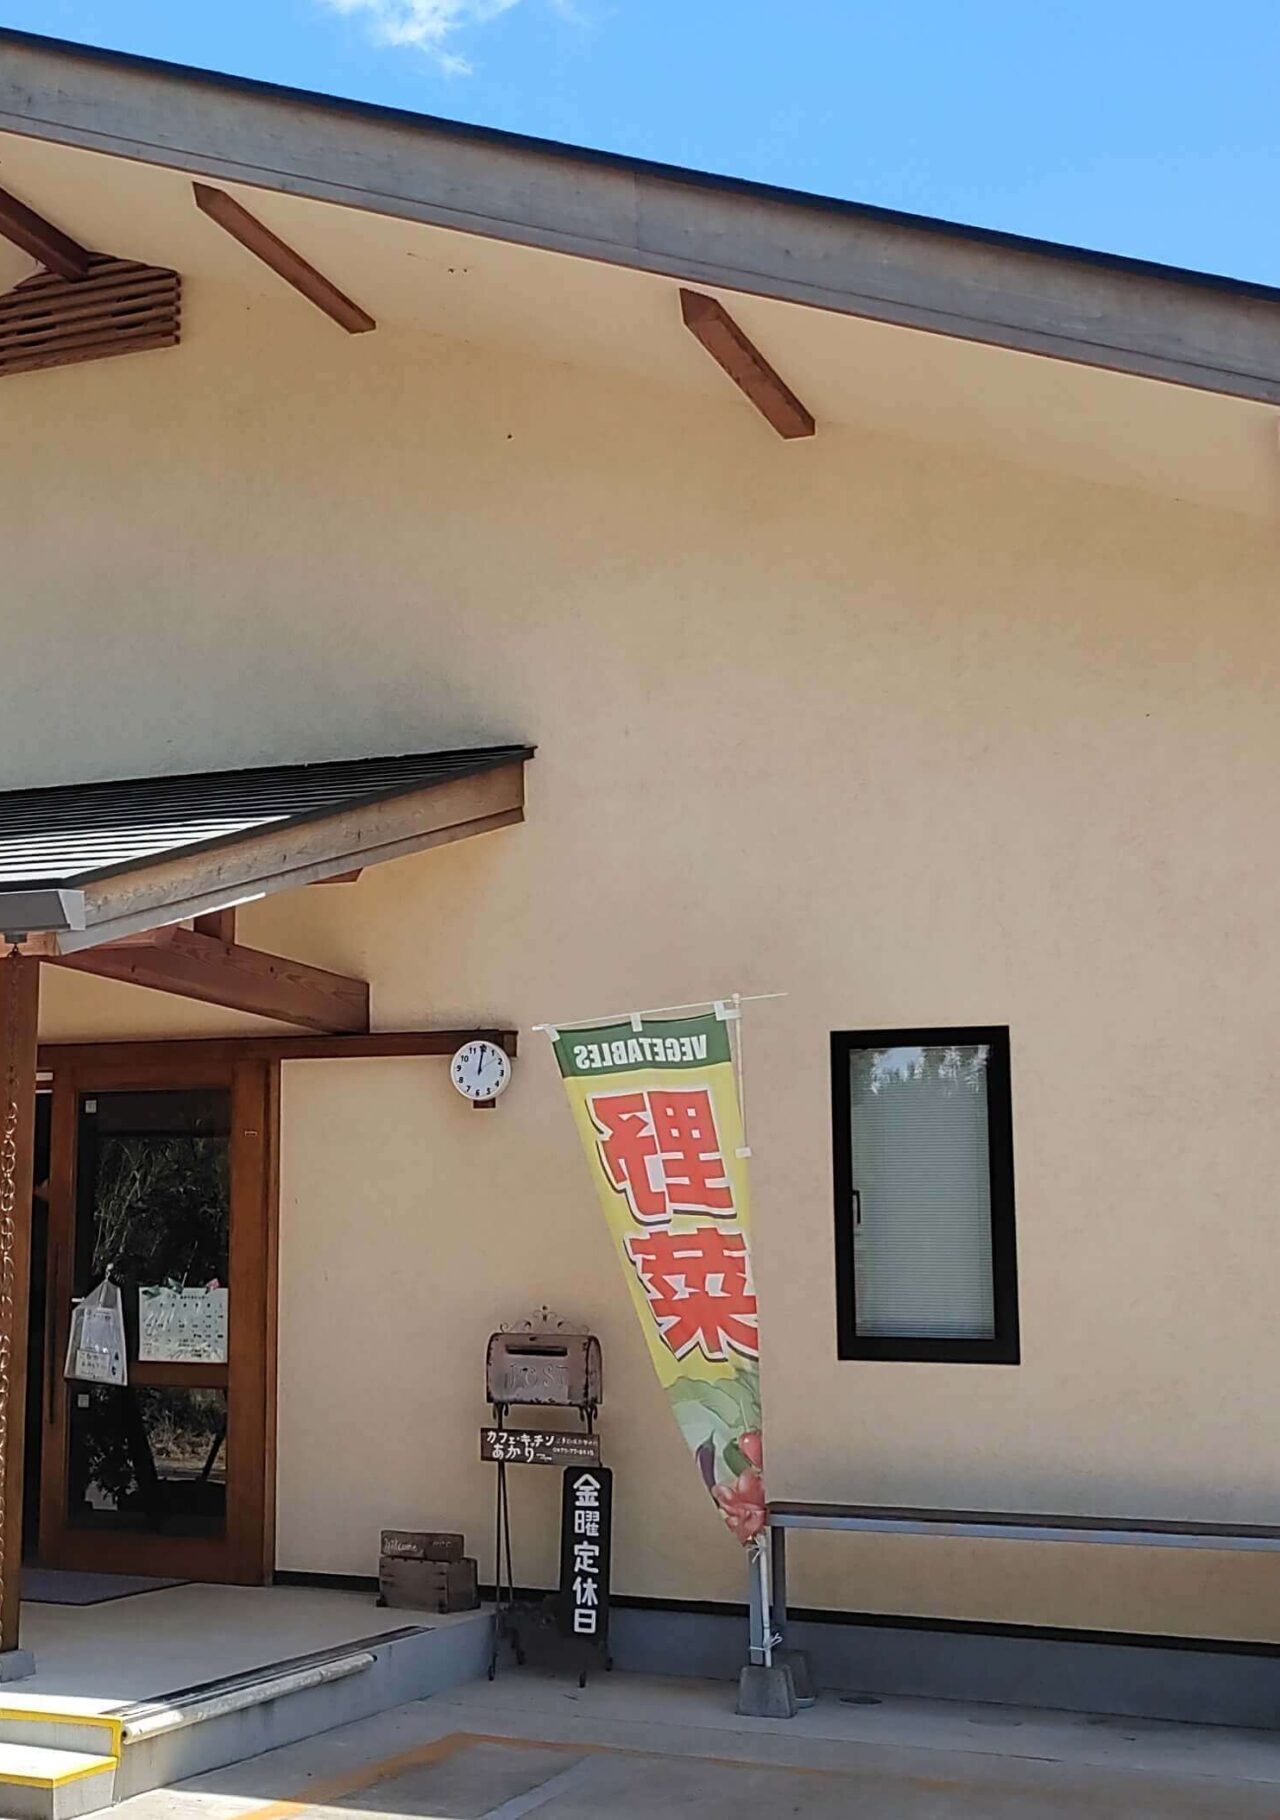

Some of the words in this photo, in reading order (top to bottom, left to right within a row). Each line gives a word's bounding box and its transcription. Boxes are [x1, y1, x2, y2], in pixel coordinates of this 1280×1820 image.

[492, 1443, 534, 1463] あかり
[572, 1473, 601, 1633] 金曜定休日
